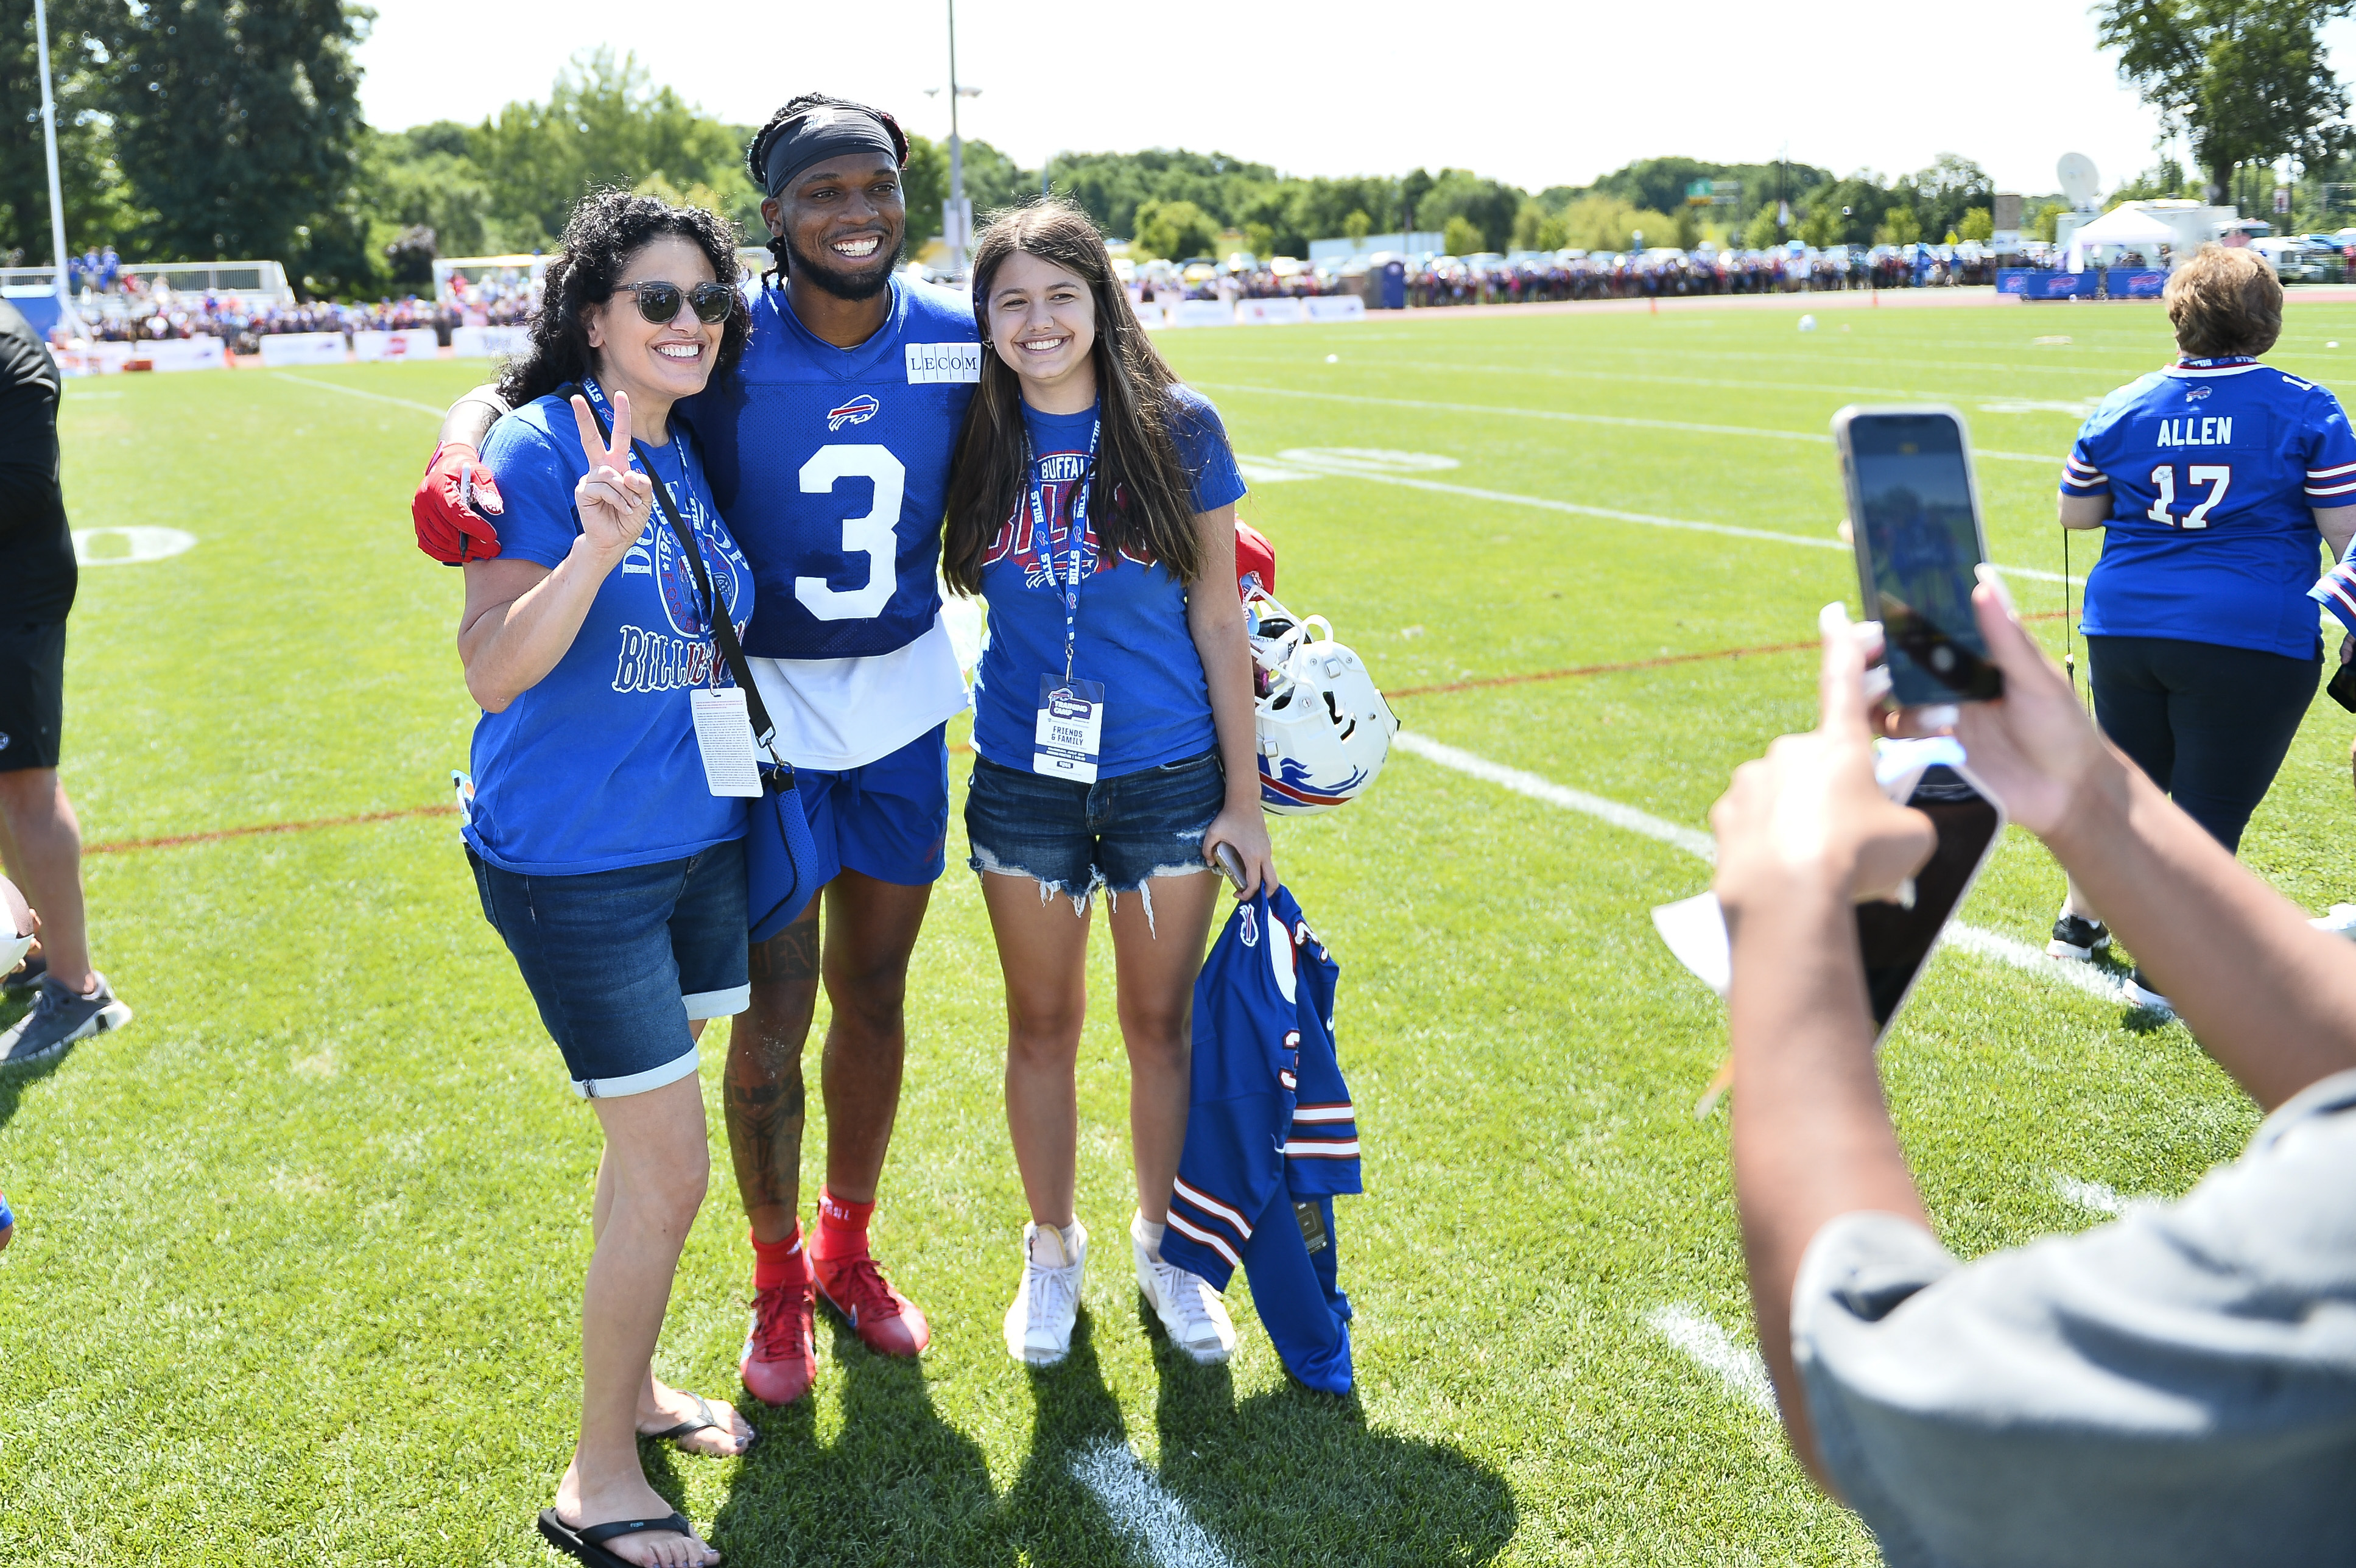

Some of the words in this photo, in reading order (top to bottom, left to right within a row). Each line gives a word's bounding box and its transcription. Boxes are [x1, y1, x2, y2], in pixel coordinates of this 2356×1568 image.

[910, 357, 977, 370] LECOM
[2157, 417, 2233, 448] ALLEN
[1031, 490, 1044, 524] BILLS
[1076, 484, 1087, 518] BILLS
[2147, 463, 2232, 529] 17
[689, 497, 702, 531] BILLS
[795, 444, 906, 621] 3
[680, 555, 698, 590] BILLS
[1041, 552, 1057, 587] BILLS
[1068, 550, 1080, 585] BILLS
[1053, 725, 1083, 738] FRIENDS
[1057, 734, 1084, 746] FAMILY
